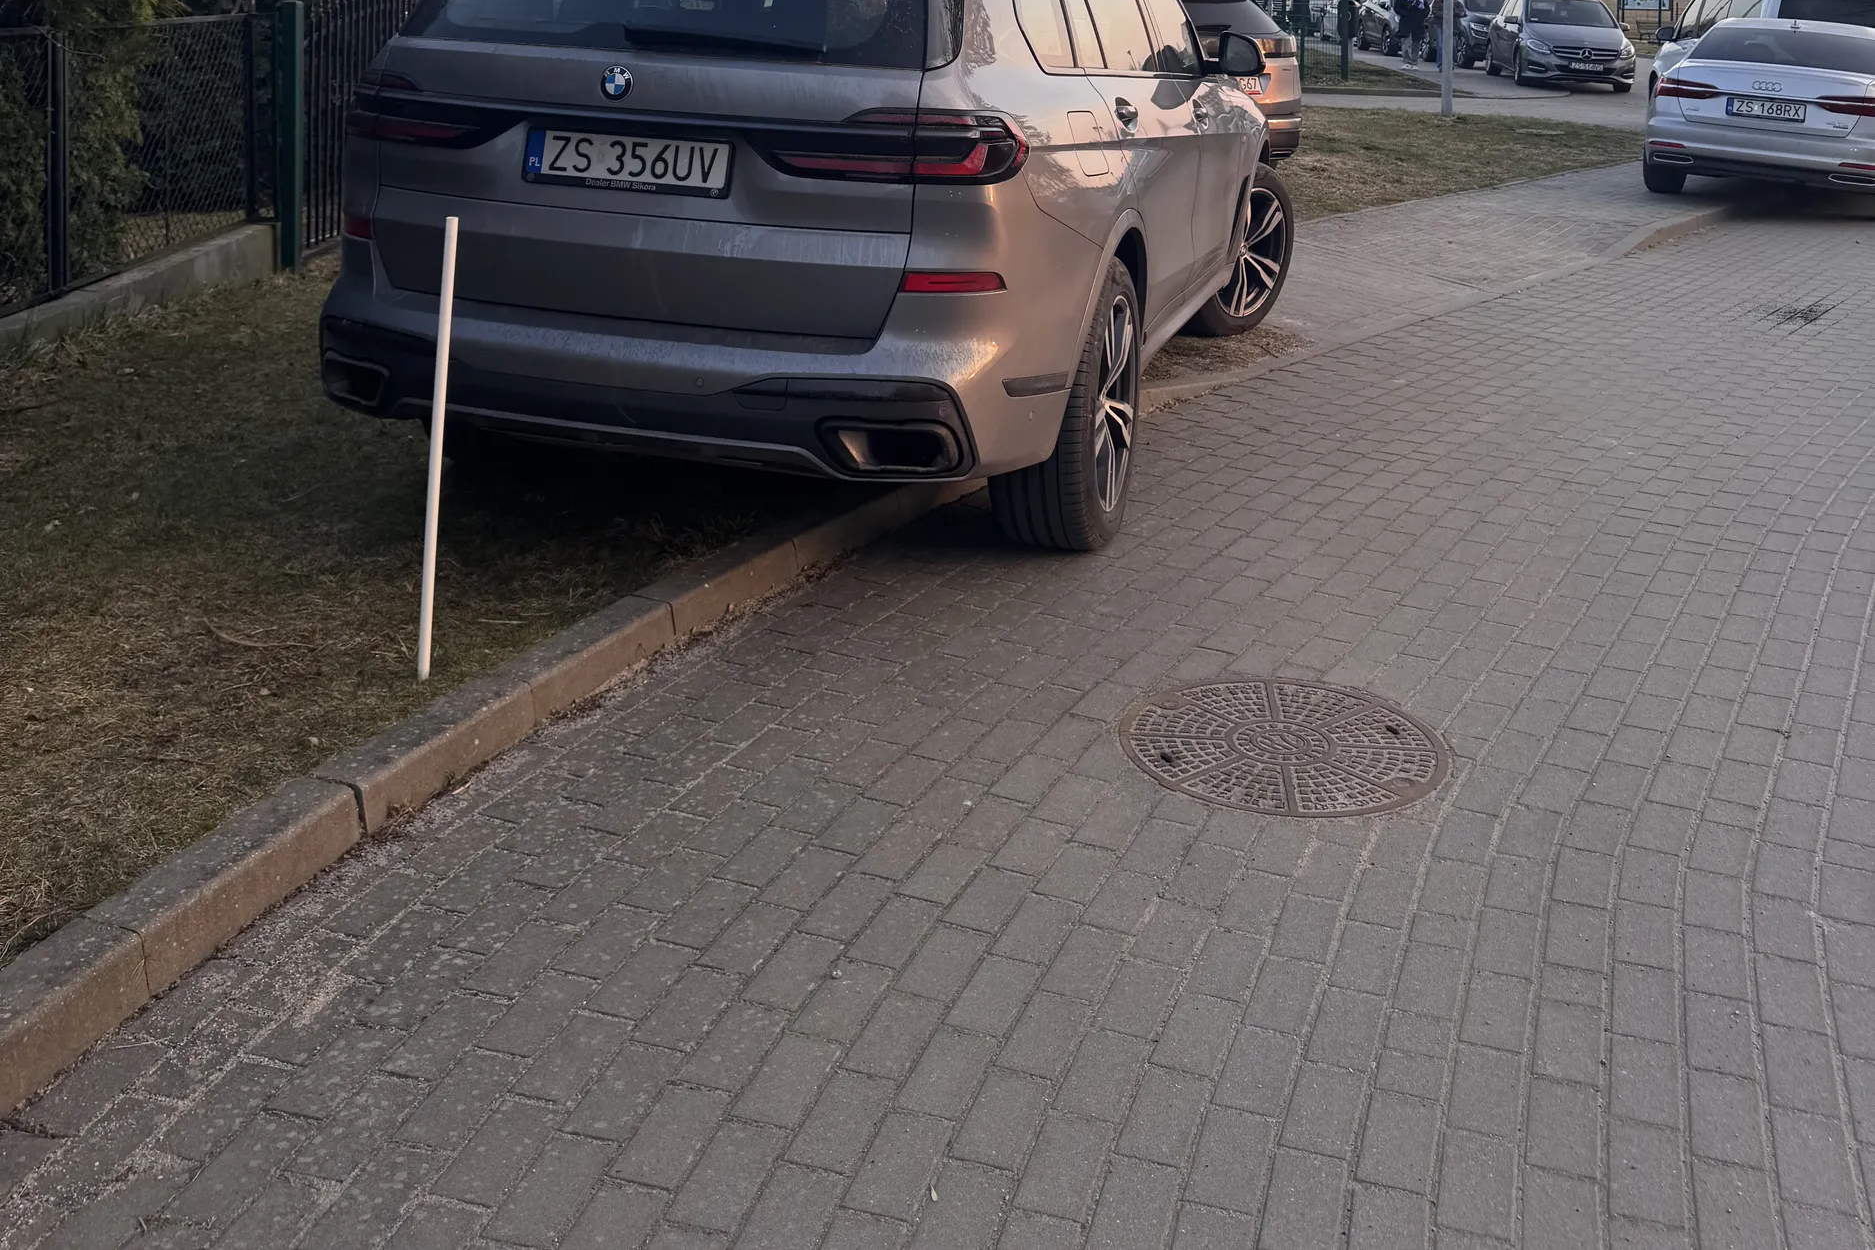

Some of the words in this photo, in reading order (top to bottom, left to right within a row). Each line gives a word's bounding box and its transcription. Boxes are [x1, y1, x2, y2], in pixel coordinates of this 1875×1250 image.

[1239, 77, 1257, 90] G67
[1736, 100, 1754, 112] ZS
[1760, 102, 1801, 118] 168RX
[529, 156, 540, 167] PL
[549, 135, 594, 173] ZS
[606, 140, 719, 184] 356UV
[585, 177, 609, 187] Dealer
[610, 180, 630, 190] BMW
[631, 182, 656, 191] Sikora
